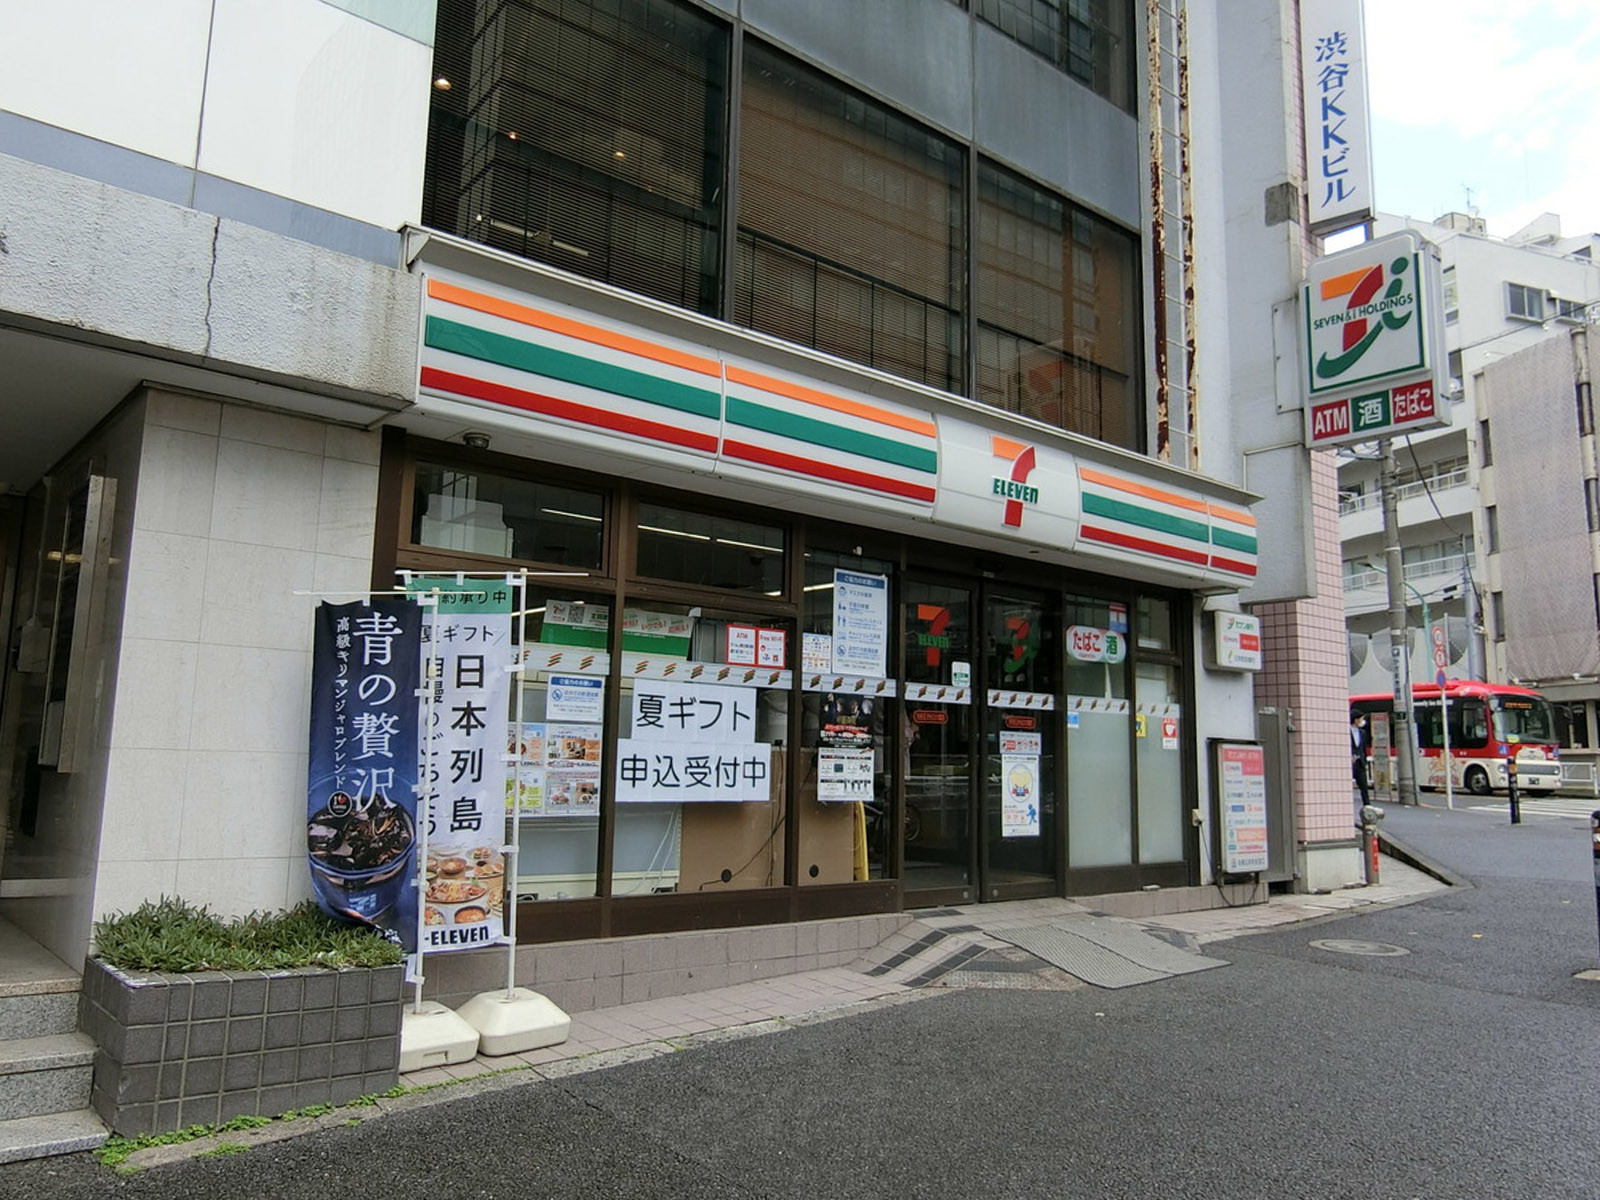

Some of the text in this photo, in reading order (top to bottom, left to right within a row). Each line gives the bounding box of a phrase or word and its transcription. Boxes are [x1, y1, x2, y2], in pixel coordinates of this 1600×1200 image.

[1314, 30, 1355, 208] 渋谷KKビル
[1359, 293, 1413, 318] HOLDINGS
[1358, 403, 1383, 427] 酒
[1394, 387, 1433, 417] たばこ
[1313, 404, 1348, 434] ATM
[1073, 630, 1101, 651] たばこ
[352, 611, 403, 811] 青の贅沢
[636, 693, 750, 731] 夏ギフト
[449, 654, 487, 833] 日本列島
[621, 753, 766, 789] 申込受付中
